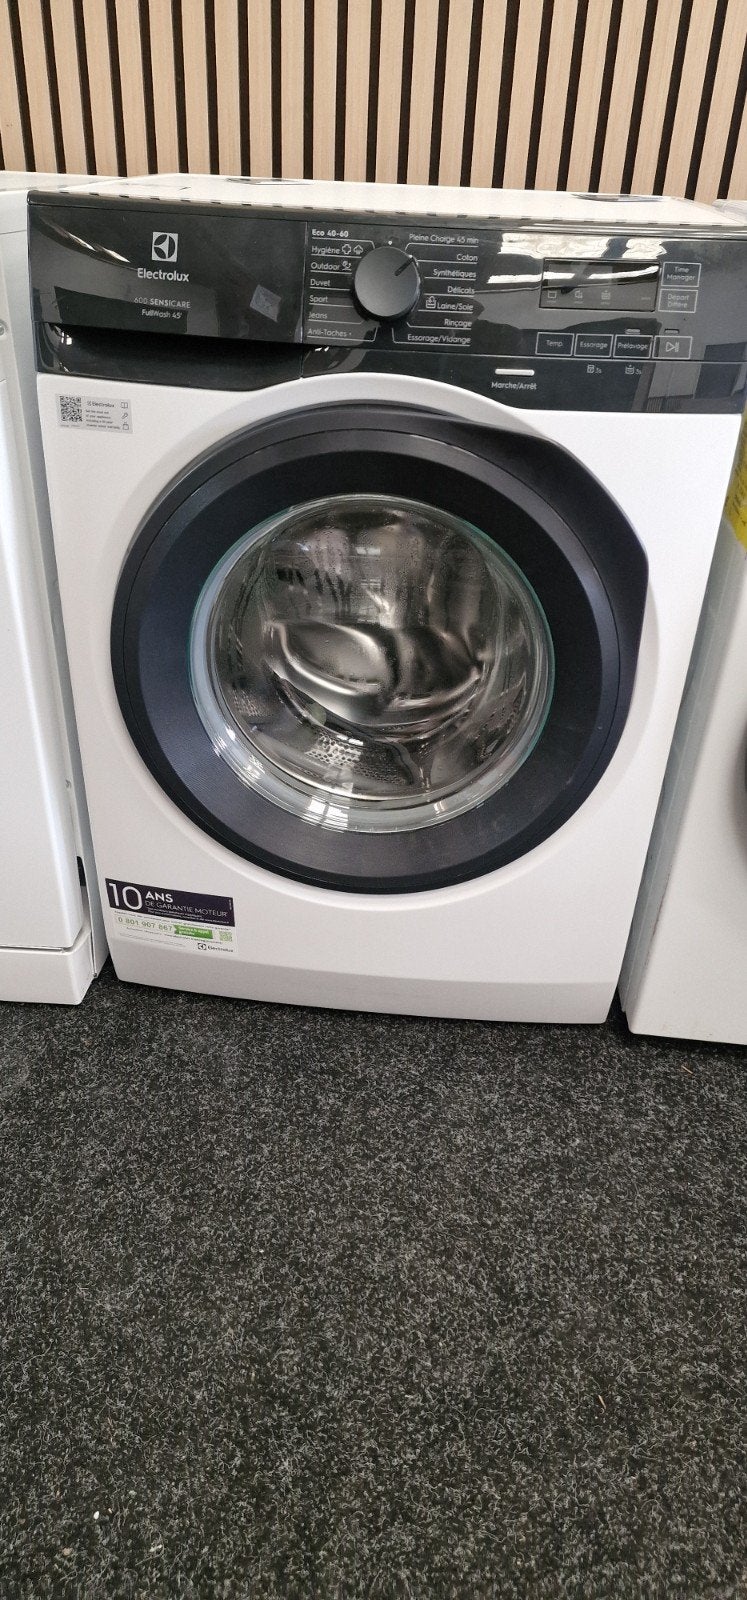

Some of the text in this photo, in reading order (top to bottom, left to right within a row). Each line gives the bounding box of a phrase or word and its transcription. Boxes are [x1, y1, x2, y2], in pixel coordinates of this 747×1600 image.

[311, 228, 349, 238] Eco 40-60
[409, 233, 429, 242] Pleine
[430, 234, 455, 244] Charge
[311, 245, 340, 255] Hygiène
[456, 253, 479, 262] Coton
[310, 261, 340, 271] Outdoor
[674, 266, 690, 274] Time
[137, 267, 190, 283] Electrolux
[666, 274, 696, 282] Manager
[310, 278, 331, 287] Duvet
[134, 297, 191, 309] 600 SENSICARE
[309, 295, 329, 304] Sport
[437, 303, 474, 312] Laine/Soie
[141, 308, 171, 318] FullWash
[308, 312, 328, 320] Jeans
[444, 318, 473, 329] Rinçage
[307, 328, 347, 338] Anti-Taches
[407, 333, 472, 345] Essorage/Vidange
[579, 340, 609, 350] Essorage
[491, 381, 538, 391] Marche/Arrêt
[108, 882, 143, 911] 10
[145, 891, 174, 903] ANS
[156, 902, 193, 913] GARANTIE
